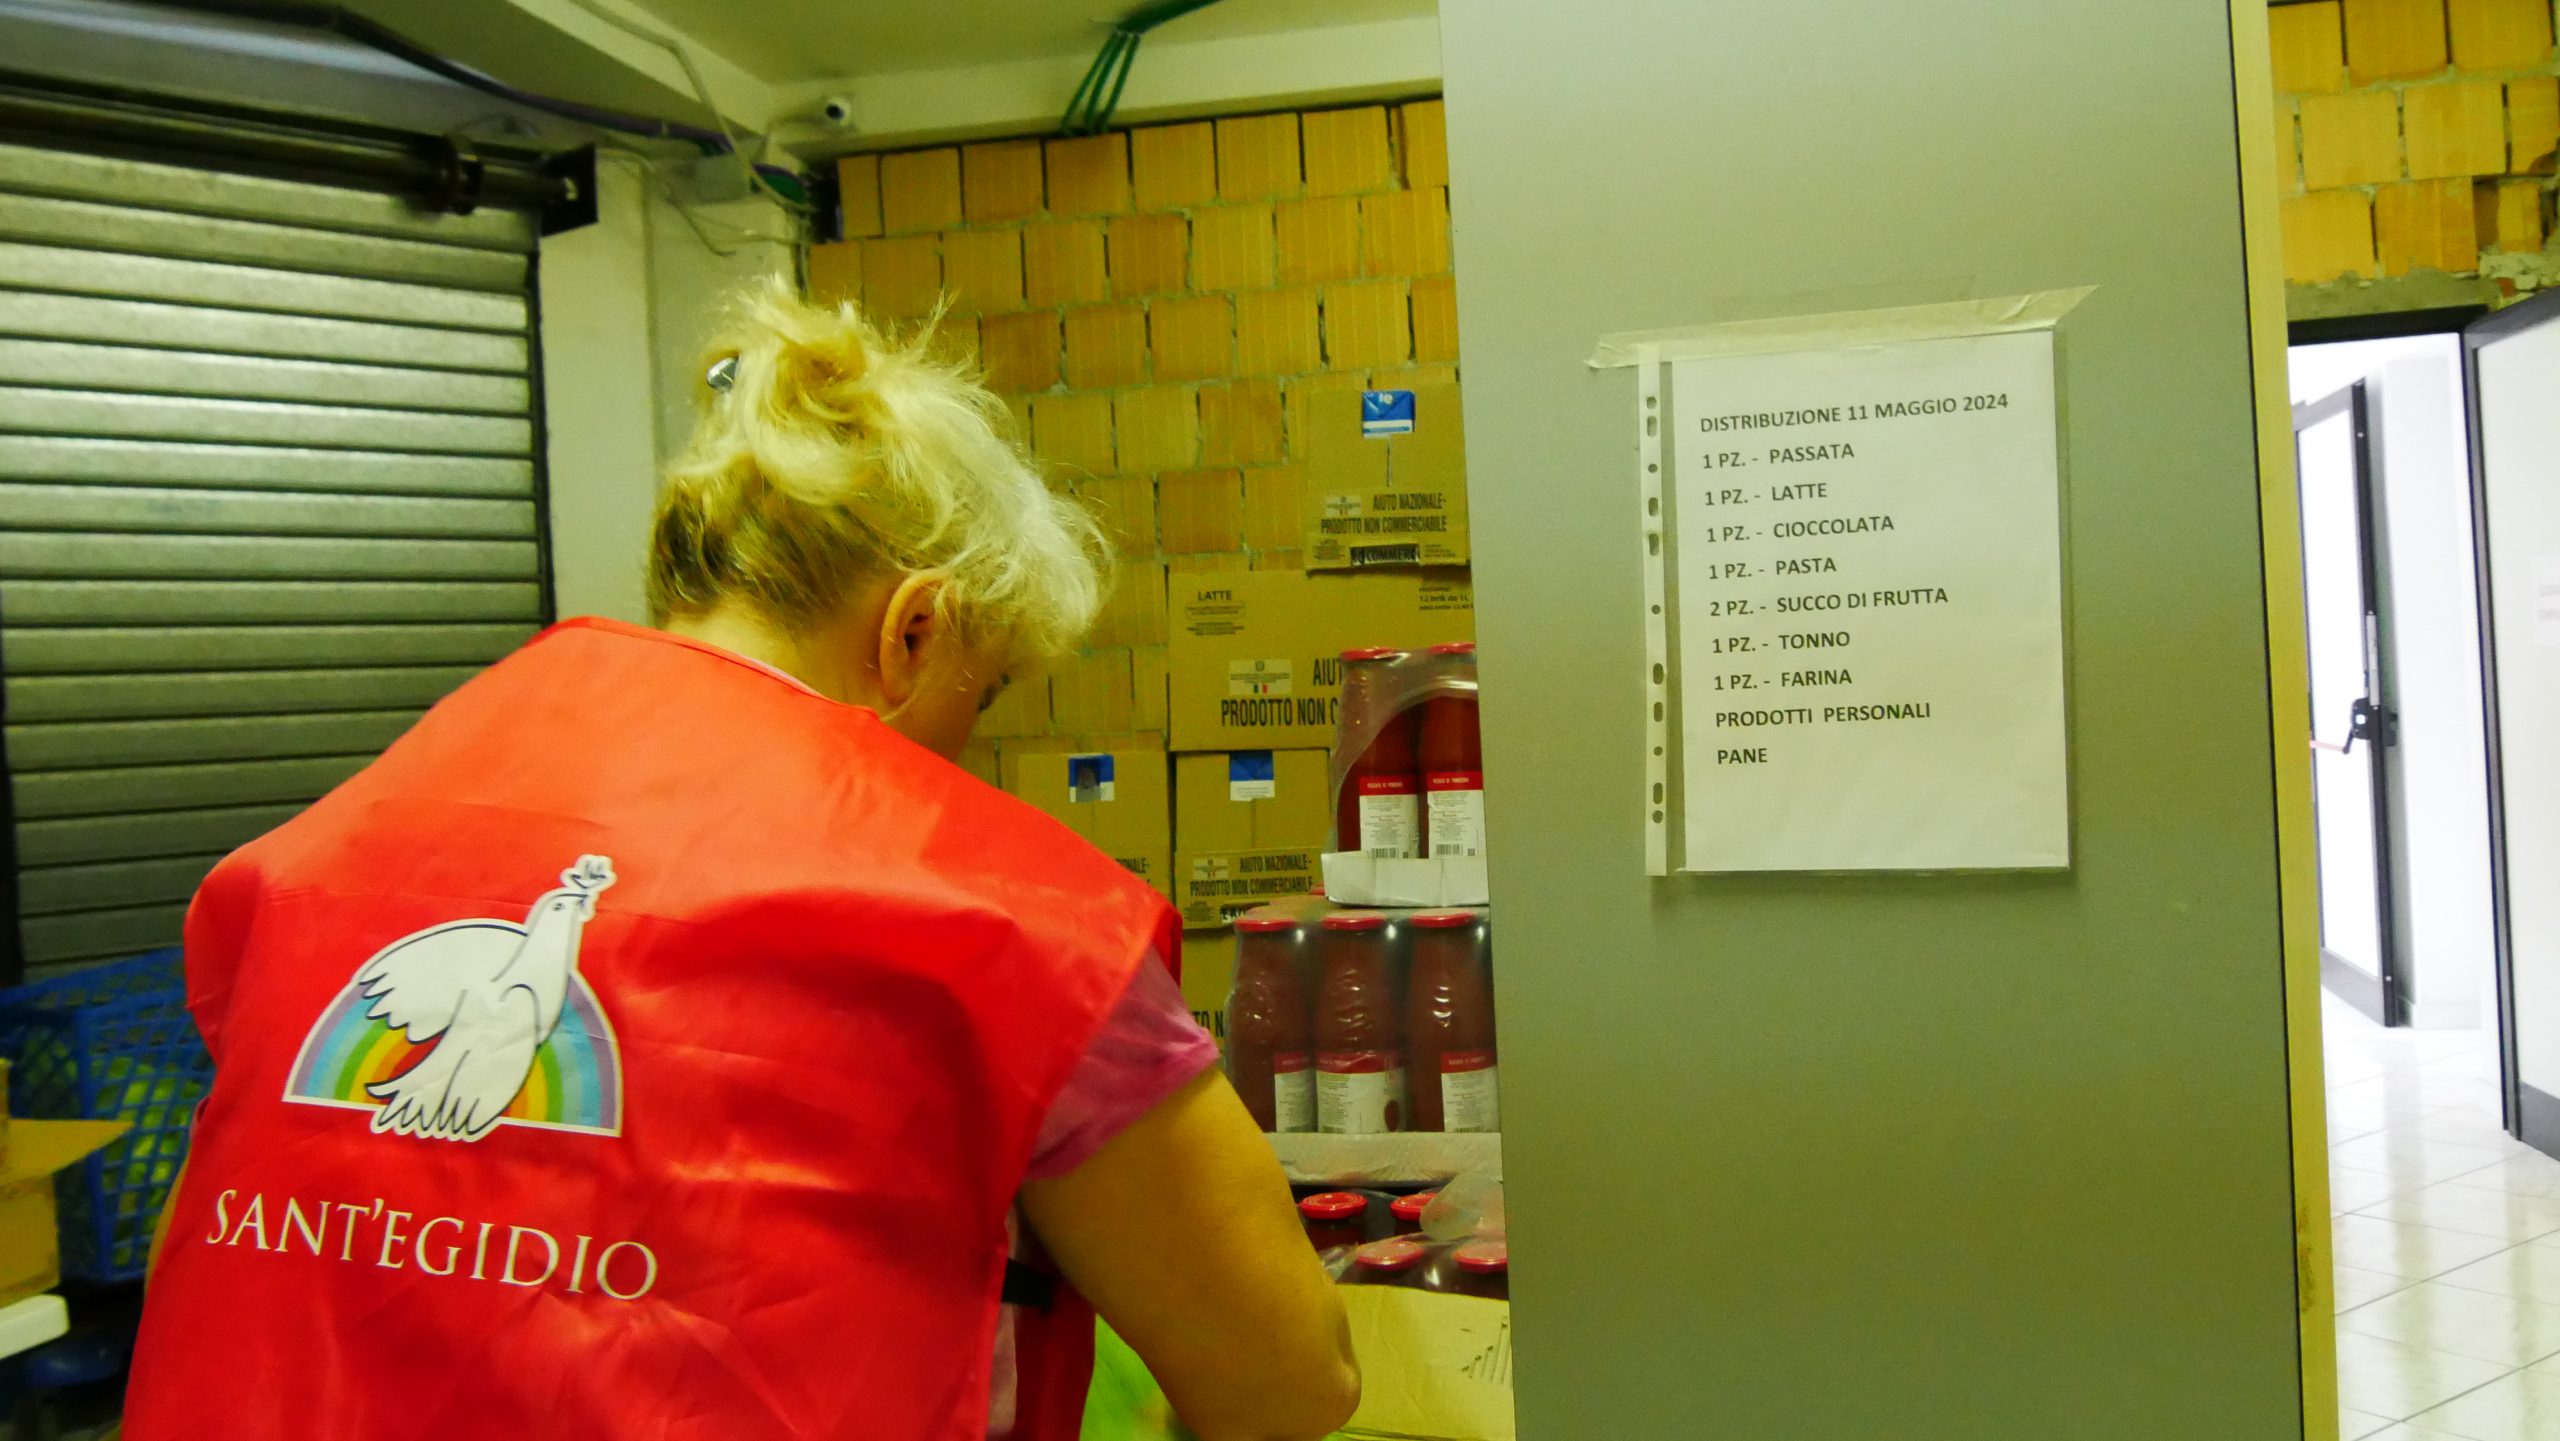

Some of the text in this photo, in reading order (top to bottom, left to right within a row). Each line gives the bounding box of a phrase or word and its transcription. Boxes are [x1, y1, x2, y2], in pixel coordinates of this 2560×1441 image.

[1700, 392, 2009, 433] DISTRIBUZIONE 11 MAGGIO 2024
[1702, 453, 1713, 470] 1
[1717, 451, 1747, 469] PZ.
[1769, 442, 1856, 465] PASSATA
[1373, 494, 1397, 510] AIUTO
[1704, 490, 1716, 507] 1
[1720, 488, 1749, 506] PZ.
[1771, 482, 1828, 502] LATTE
[1321, 515, 1447, 534] PRODOTTO NON COMMERCIABILE
[1706, 527, 1717, 543] 1
[1722, 525, 1751, 543] PZ.
[1772, 514, 1895, 539] CIOCCOLATA
[1708, 564, 1719, 580] 1
[1724, 562, 1753, 580] PZ.
[1775, 556, 1838, 576] PASTA
[1198, 590, 1232, 601] LATTE
[1709, 600, 1721, 617] 2
[1726, 599, 1755, 616] PZ.
[1776, 593, 1842, 614] SUCCO
[1847, 592, 1867, 609] DI
[1872, 587, 1950, 608] FRUTTA
[1711, 638, 1723, 654] 1
[1728, 636, 1757, 653] PZ.
[1777, 630, 1851, 651] TONNO
[1313, 657, 1342, 686] AIUT
[1713, 674, 1725, 691] 1
[1729, 673, 1758, 690] PZ.
[1780, 668, 1853, 688] FARINA
[1221, 697, 1293, 727] PRODOTTO
[1296, 697, 1326, 726] NON
[1715, 701, 1931, 729] PRODOTTI PERSONALI
[1716, 747, 1769, 766] PANE
[1240, 856, 1263, 873] AIUTO
[1190, 880, 1230, 896] PRODOTTO
[1231, 879, 1248, 895] NON
[196, 1189, 658, 1300] SANT'EGIDIO
